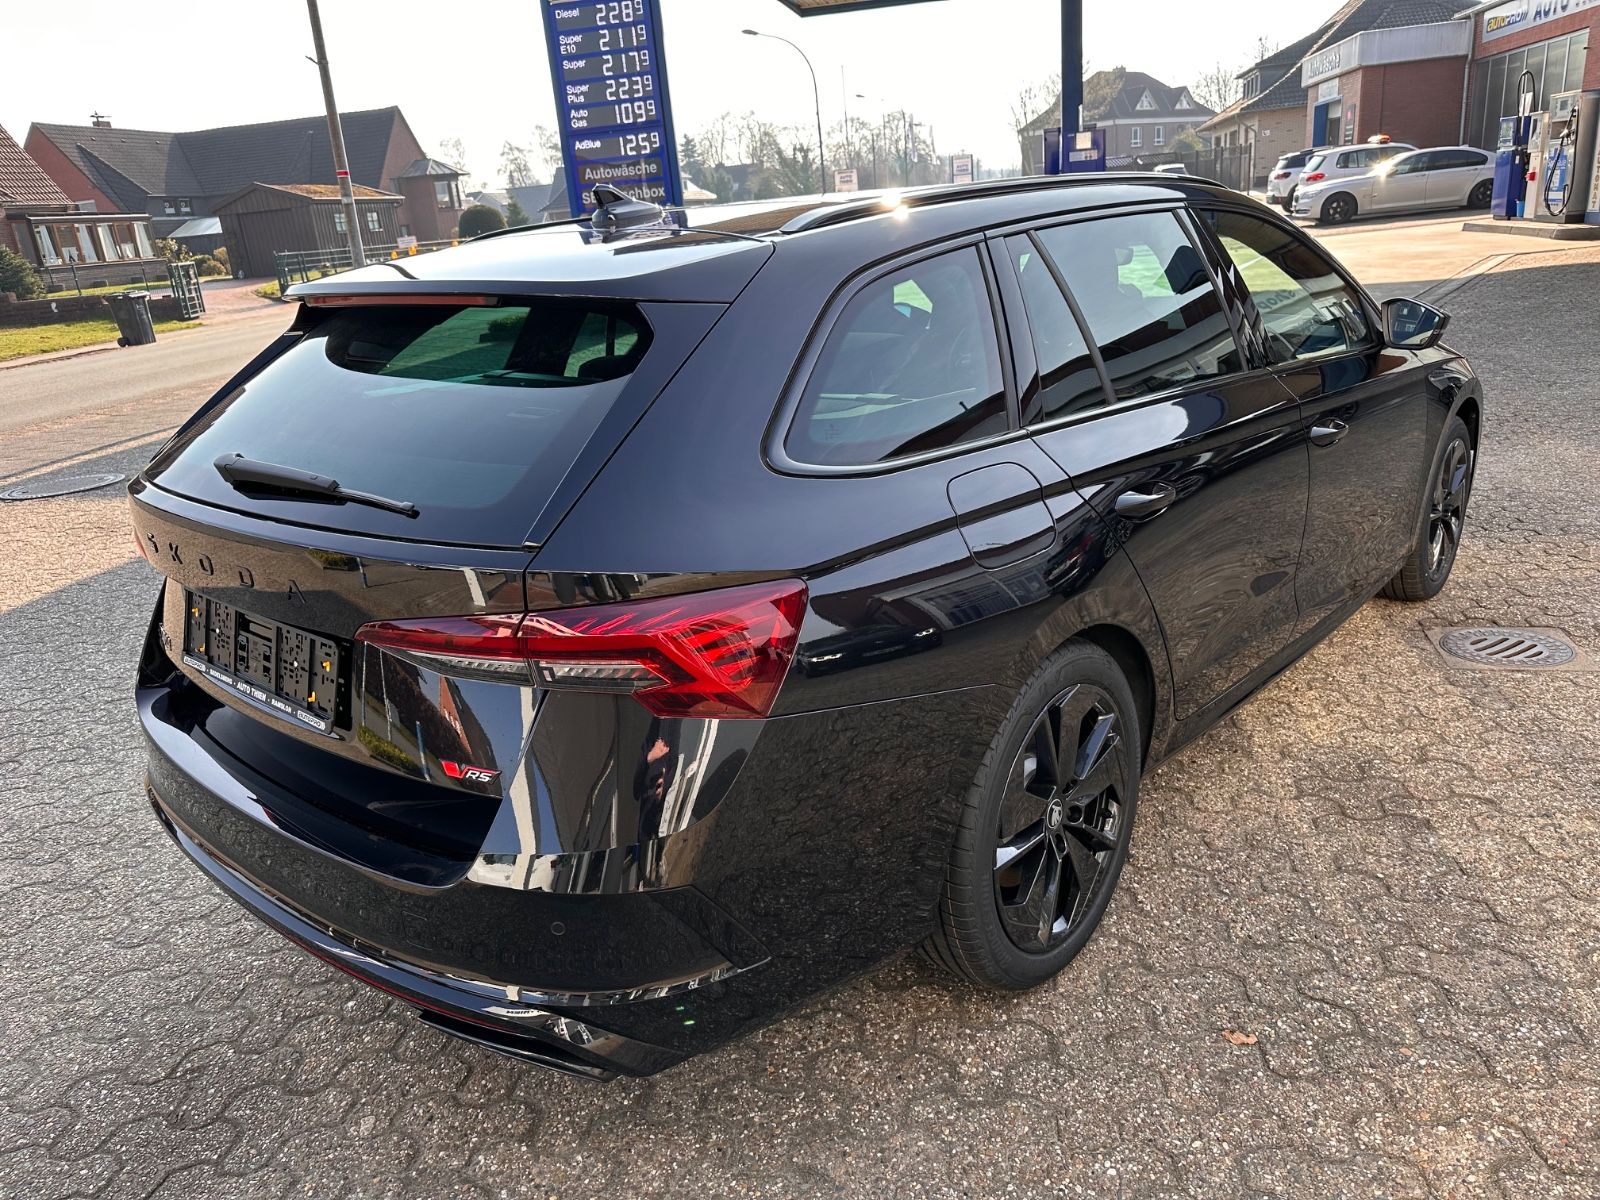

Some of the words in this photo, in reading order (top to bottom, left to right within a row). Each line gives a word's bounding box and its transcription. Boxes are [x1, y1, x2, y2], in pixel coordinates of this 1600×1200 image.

[555, 9, 579, 19] Diesel
[559, 34, 582, 45] Super
[560, 45, 576, 54] E10
[562, 60, 586, 70] Super
[566, 85, 589, 96] Super
[567, 95, 584, 103] Plus
[570, 109, 588, 119] Auto
[571, 119, 587, 128] Gas
[575, 140, 601, 150] AdBlue
[585, 163, 657, 180] Autowäsche
[236, 682, 251, 694] AUTO
[251, 688, 267, 702] THIEN
